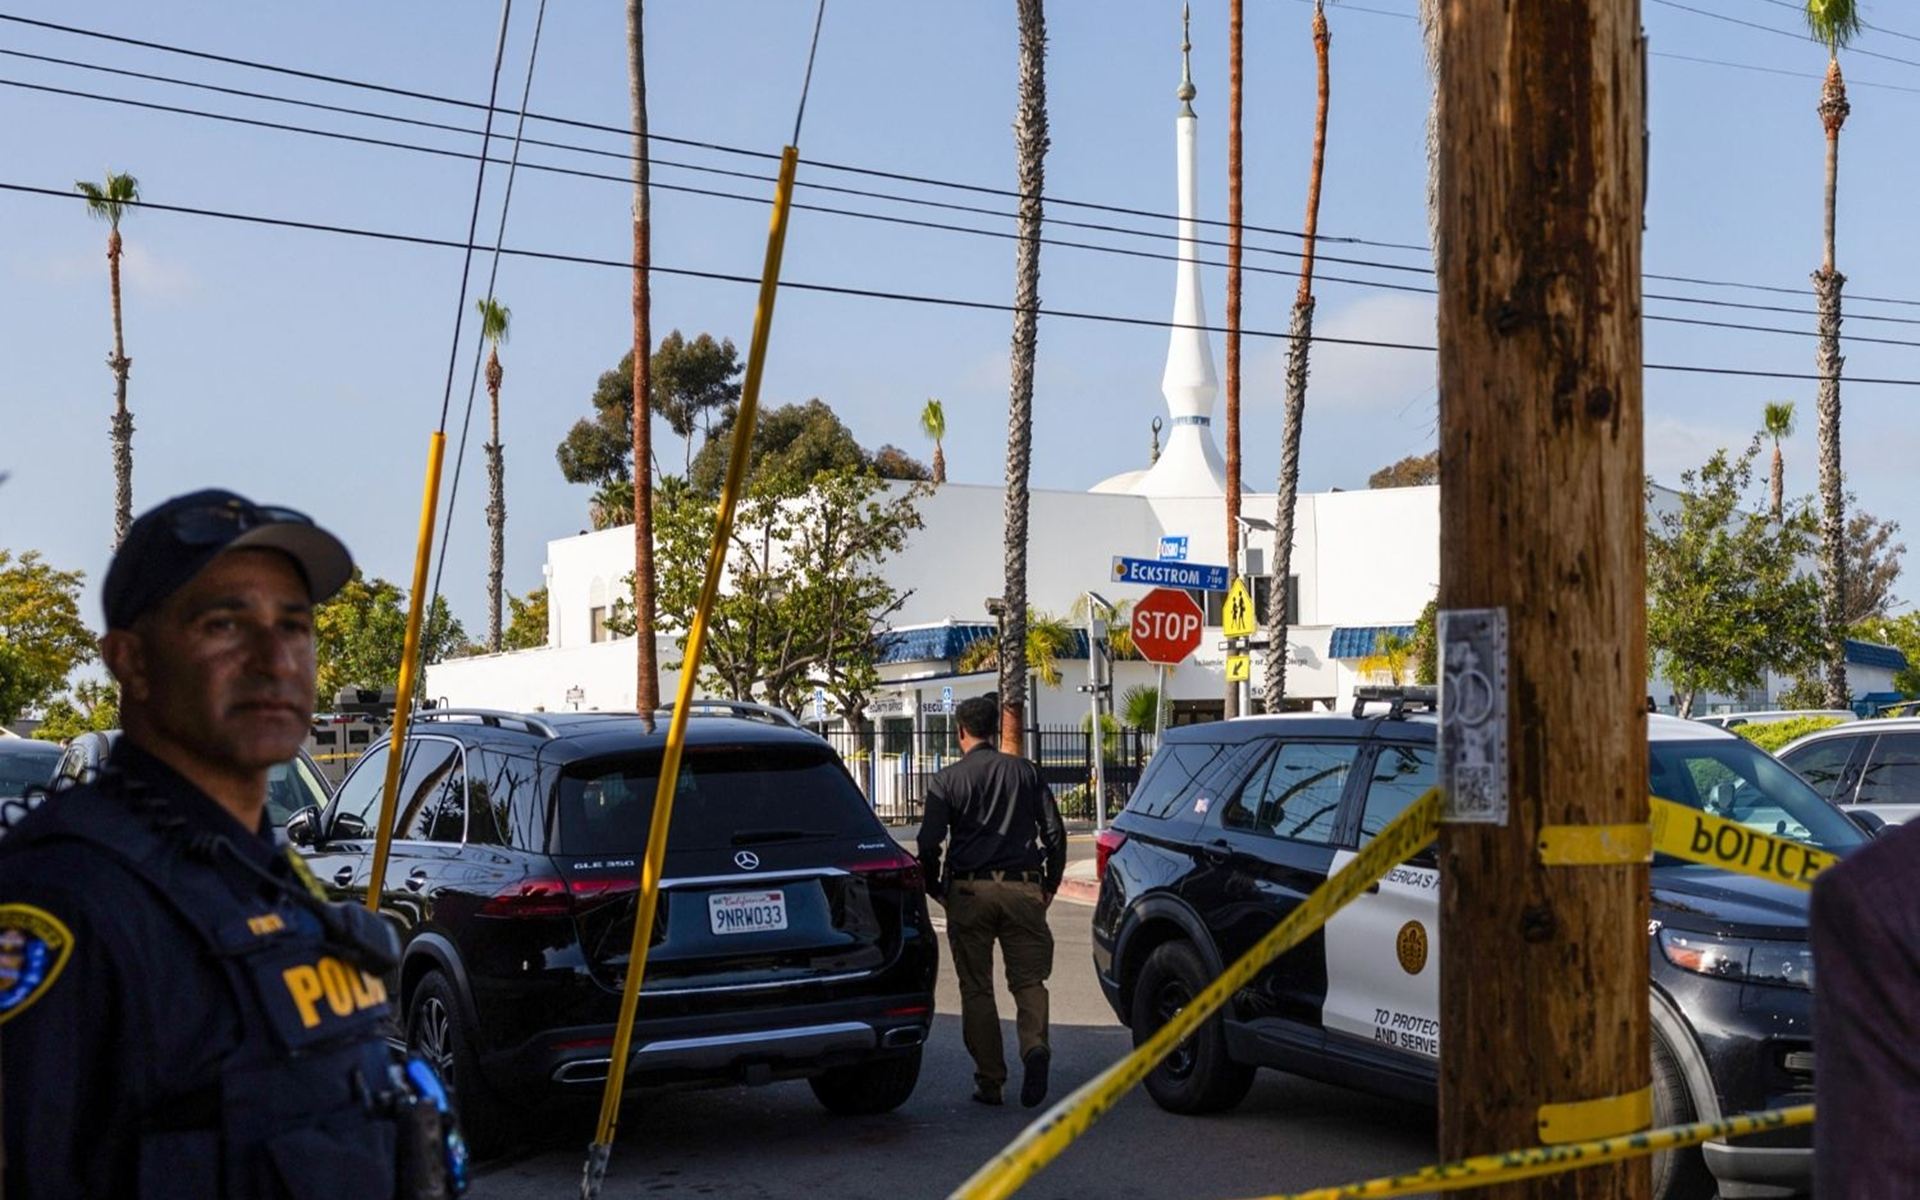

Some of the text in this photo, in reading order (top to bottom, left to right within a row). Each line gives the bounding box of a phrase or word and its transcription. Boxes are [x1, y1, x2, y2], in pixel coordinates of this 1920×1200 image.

[1130, 562, 1200, 585] ECKSTROM
[1135, 610, 1199, 641] STOP
[716, 905, 782, 929] 9NRW033
[1374, 1008, 1439, 1036] TO PROTEC
[1375, 1026, 1438, 1055] AND SERVE
